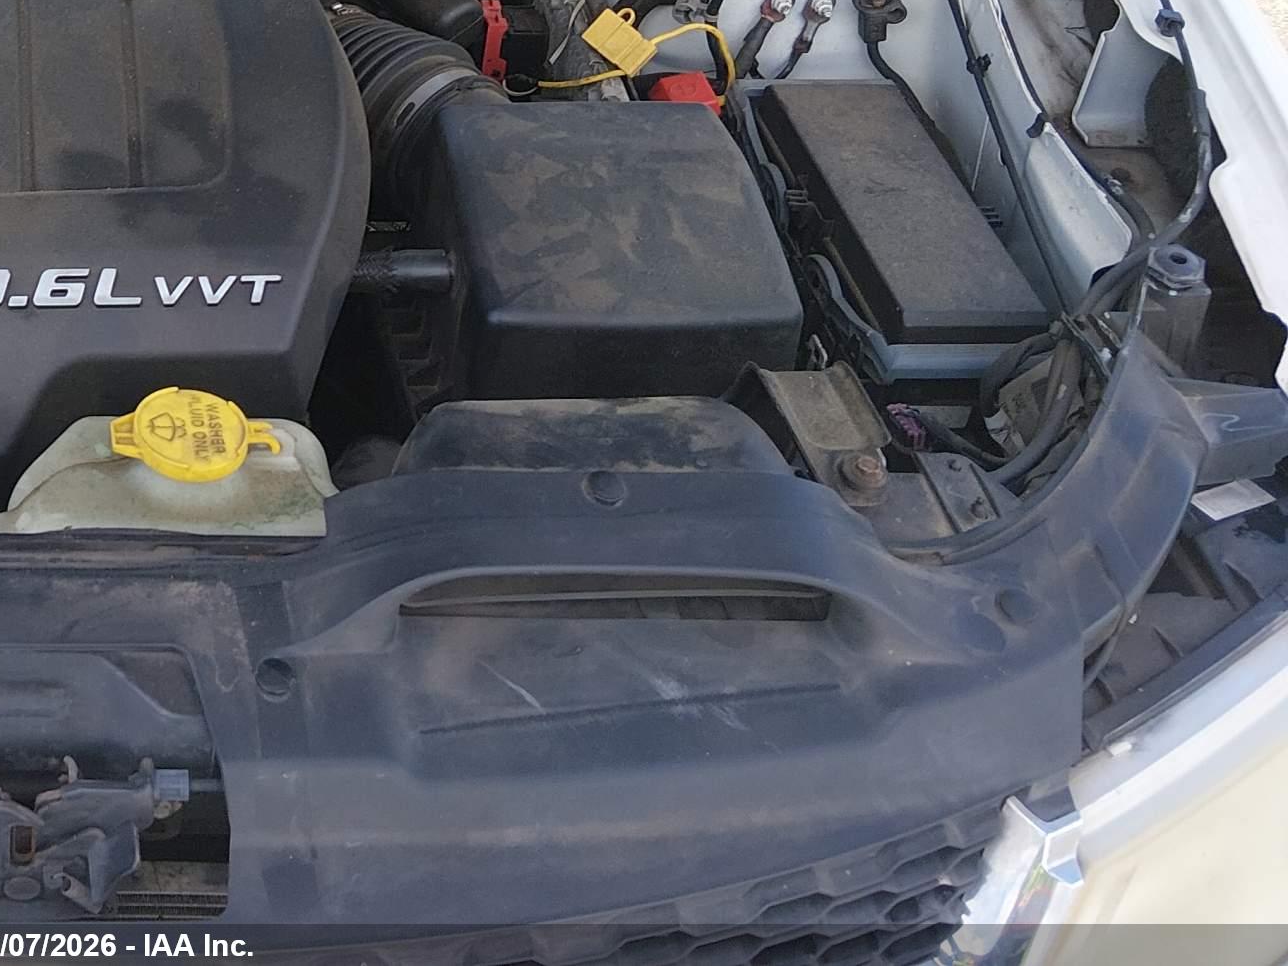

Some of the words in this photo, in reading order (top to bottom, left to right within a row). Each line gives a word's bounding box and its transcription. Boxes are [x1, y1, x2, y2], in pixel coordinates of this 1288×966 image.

[154, 274, 283, 306] VVT
[205, 402, 227, 455] WASHER
[192, 431, 211, 464] ONLY
